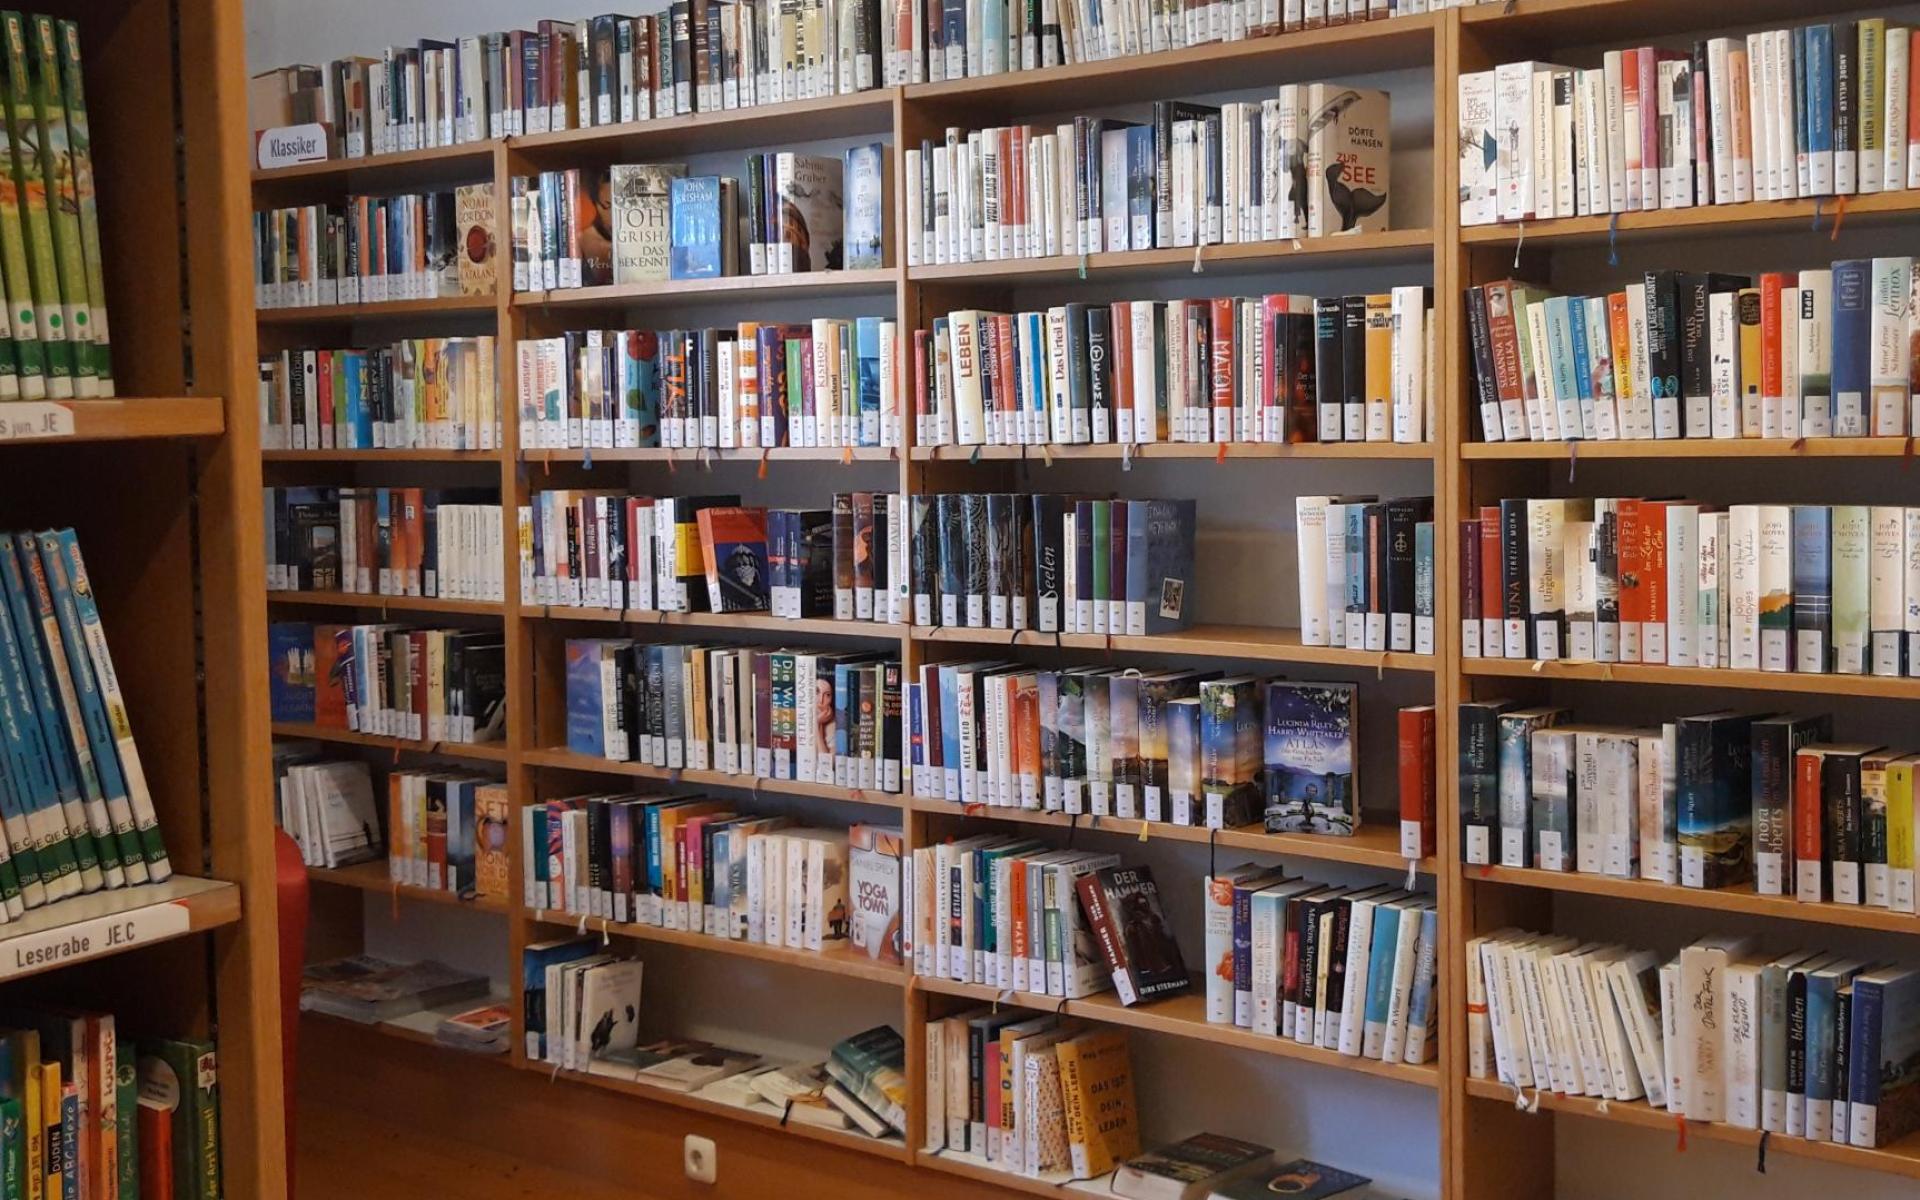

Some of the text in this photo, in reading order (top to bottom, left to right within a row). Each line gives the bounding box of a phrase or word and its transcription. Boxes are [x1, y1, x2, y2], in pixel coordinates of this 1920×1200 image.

[270, 137, 317, 158] Klassiker
[1348, 126, 1375, 137] DÖRTE
[1351, 137, 1383, 149] HANSEN
[1336, 152, 1358, 164] ZUR
[1341, 166, 1376, 185] SEE
[642, 246, 665, 255] DAS
[1694, 284, 1705, 323] LÜGEN
[1650, 329, 1660, 354] DAVID
[1686, 316, 1697, 349] HAUS
[817, 341, 827, 388] KISHON
[957, 323, 973, 379] LEBEN
[1053, 327, 1065, 381] Das Urteil
[1212, 340, 1233, 401] MATOU
[40, 412, 58, 433] JE
[1038, 545, 1057, 602] Seelen
[1745, 590, 1755, 624] moyes
[782, 660, 793, 743] Die Wurzeln
[1758, 807, 1769, 843] nora
[1768, 807, 1784, 854] oberts
[857, 879, 888, 899] YOGA
[1104, 881, 1157, 900] HAMMER
[1113, 870, 1139, 886] DER
[857, 894, 889, 917] TOWN
[16, 921, 136, 968] Leserabe JE.C
[1303, 907, 1317, 998] Marlene Streeruwitz
[1792, 996, 1804, 1041] bleiben
[52, 1131, 62, 1173] DUDEN
